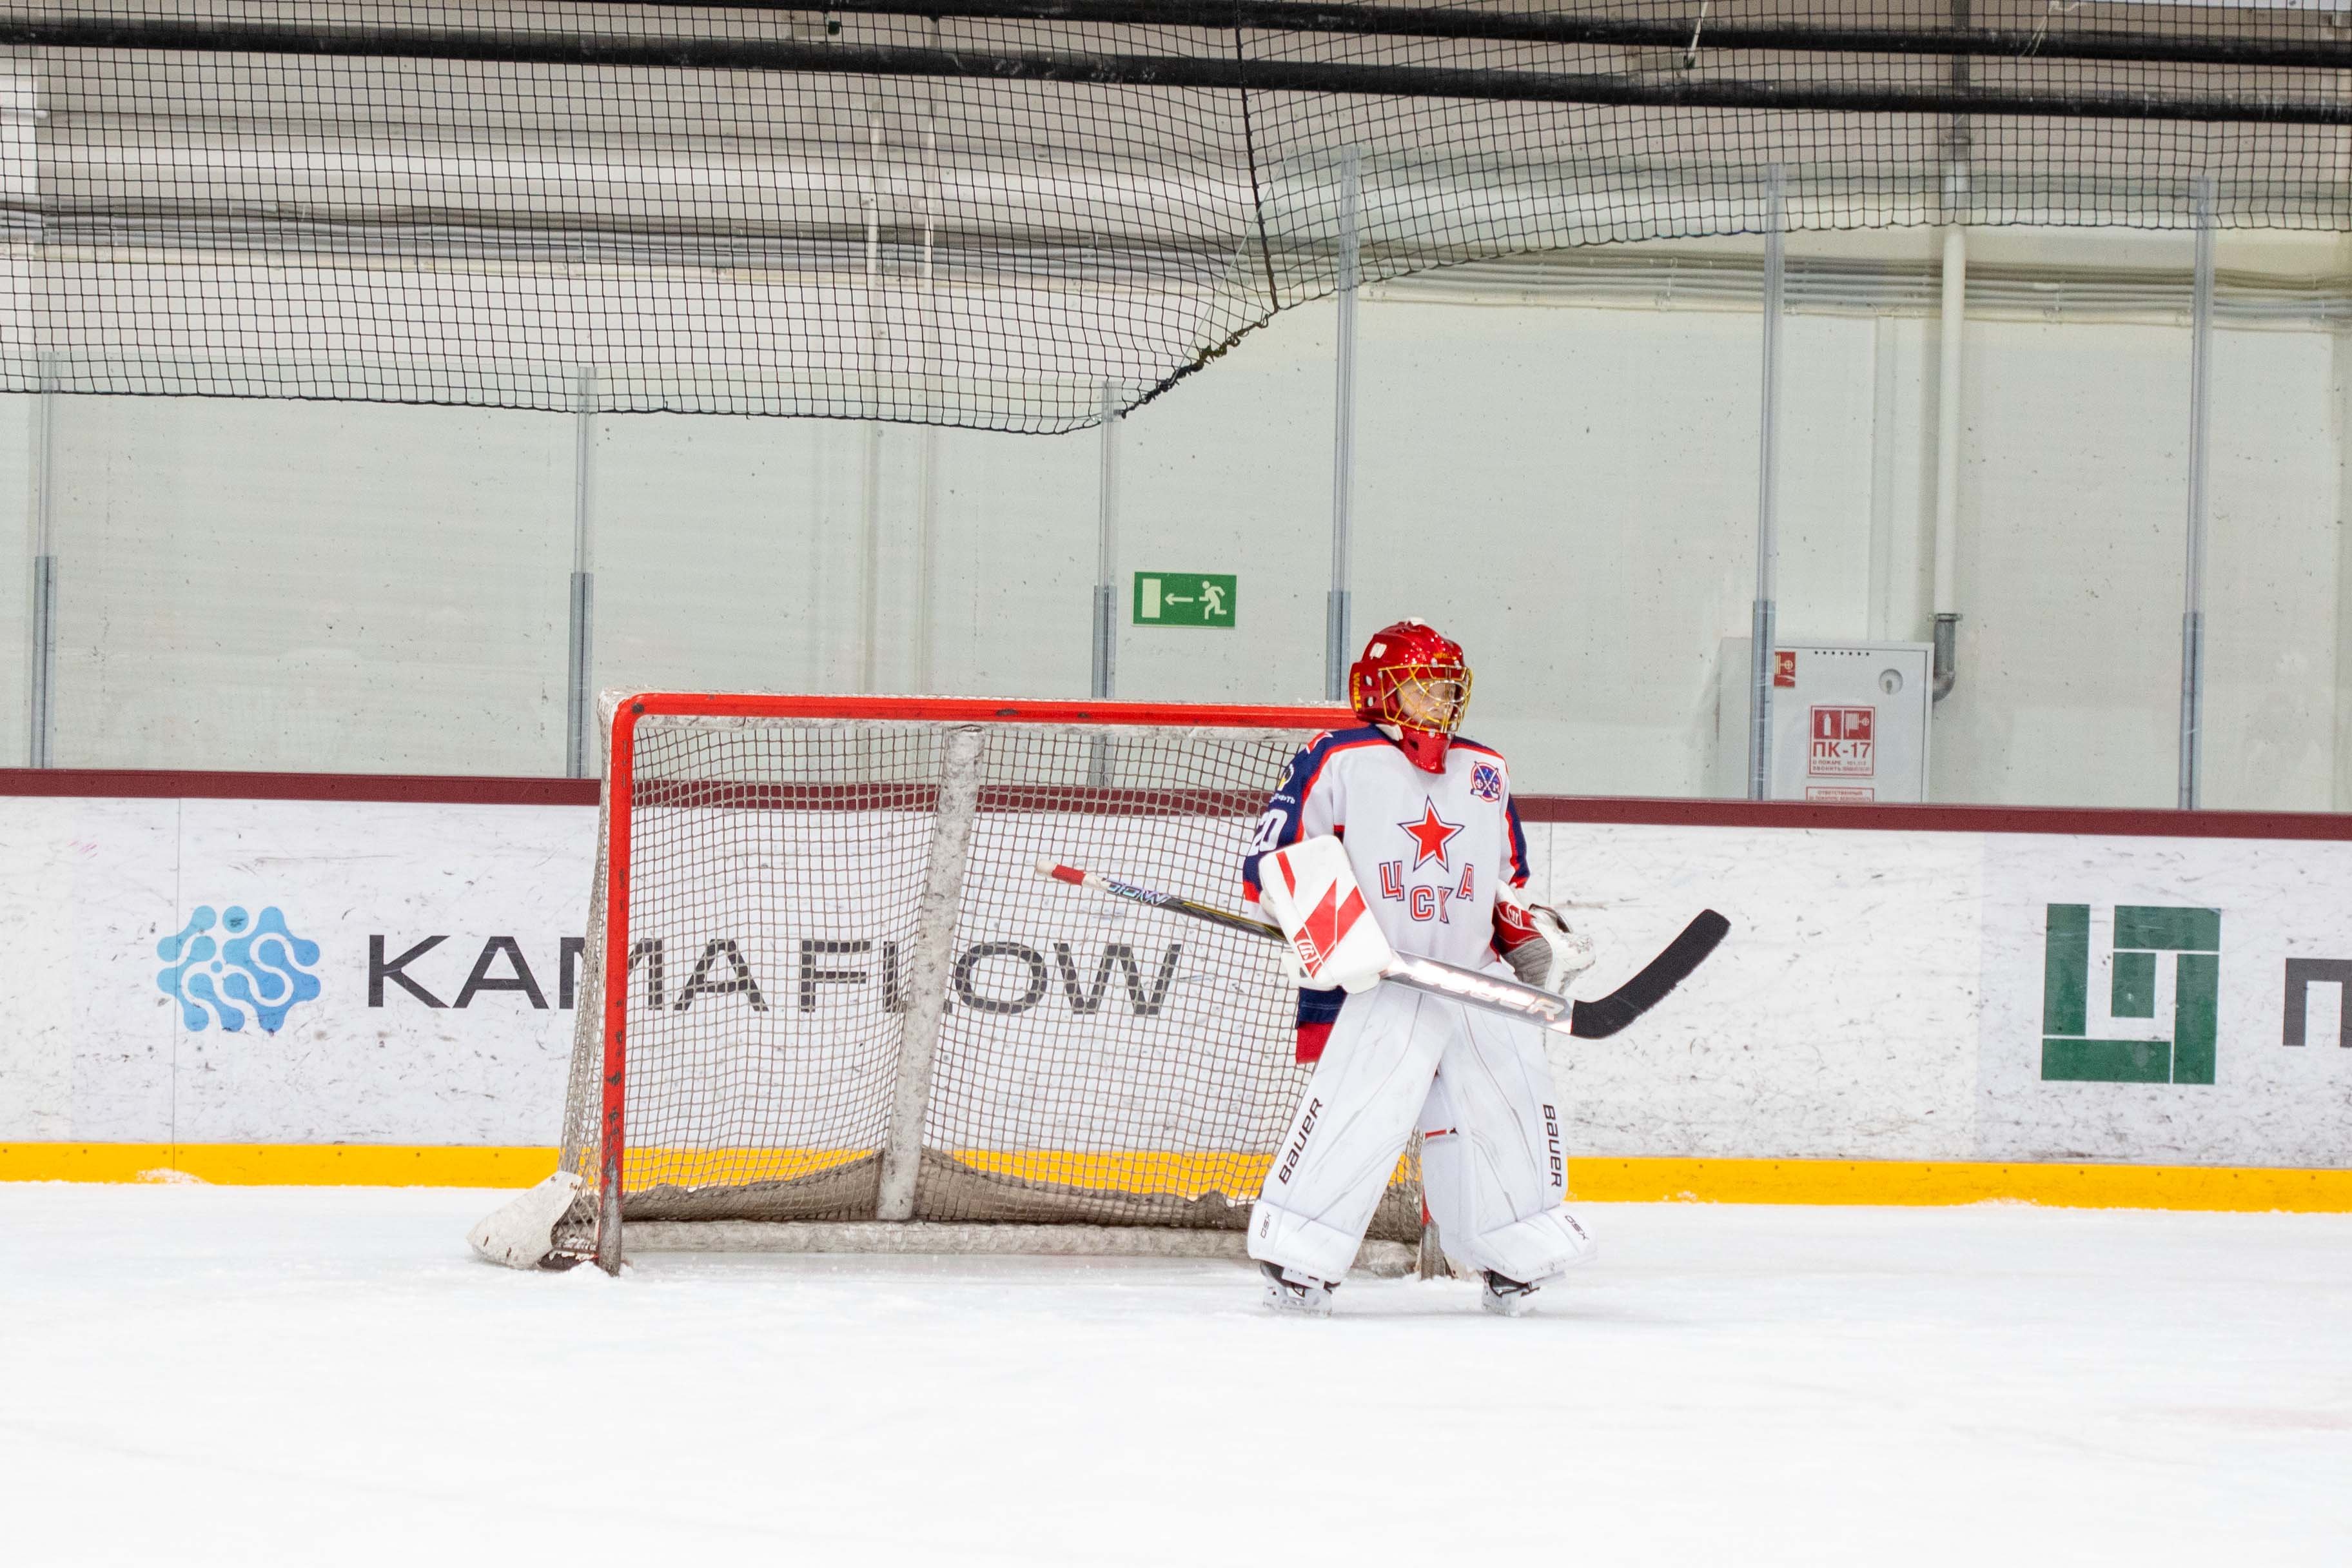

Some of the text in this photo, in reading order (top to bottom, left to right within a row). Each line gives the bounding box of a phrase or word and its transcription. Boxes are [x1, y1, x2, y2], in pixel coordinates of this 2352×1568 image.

[1812, 741, 1871, 759] ПК-17
[1378, 860, 1475, 924] ЦСКА
[367, 934, 1181, 1016] KAMA FLOW
[1279, 1097, 1323, 1185] BAUER
[1542, 1104, 1562, 1187] BAUER
